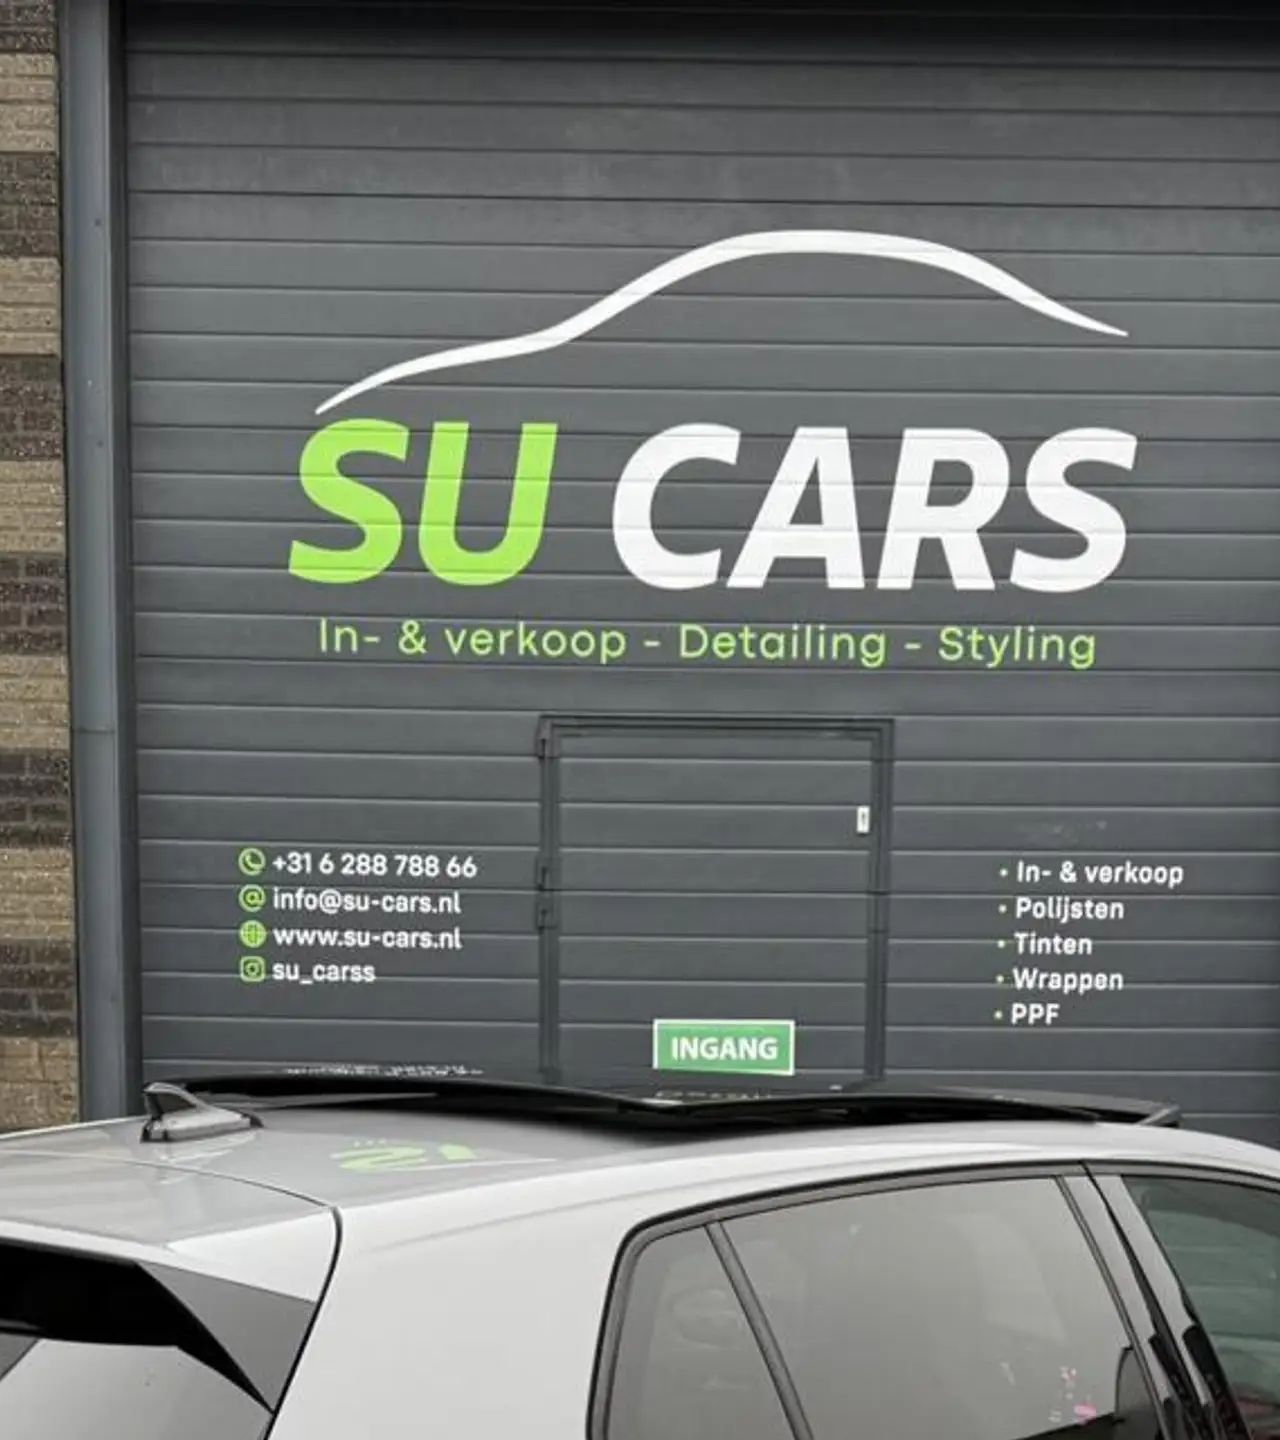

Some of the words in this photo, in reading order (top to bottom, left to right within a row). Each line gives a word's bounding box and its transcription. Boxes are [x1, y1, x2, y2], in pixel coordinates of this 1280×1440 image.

[288, 418, 558, 586] SU
[611, 422, 1138, 593] CARS
[319, 616, 381, 654] In-
[398, 618, 427, 655] &
[444, 620, 627, 665] verkoop
[679, 623, 887, 669] Detailing
[938, 626, 1097, 670] Styling
[272, 852, 312, 875] +31
[319, 854, 335, 876] 6
[340, 854, 388, 877] 288
[394, 855, 440, 877] 788
[445, 856, 479, 879] 66
[1016, 860, 1053, 883] In-
[1059, 860, 1078, 884] &
[1084, 860, 1184, 890] verkoop
[272, 886, 463, 915] info@su-cars.nl
[1015, 896, 1125, 924] Polijsten
[272, 927, 464, 949] www.su-cars.nl
[1014, 930, 1093, 955] Tinten
[272, 962, 377, 986] su_carss
[1012, 967, 1125, 996] Wrappen
[1010, 1002, 1061, 1025] PPF
[671, 1036, 779, 1061] INGANG
